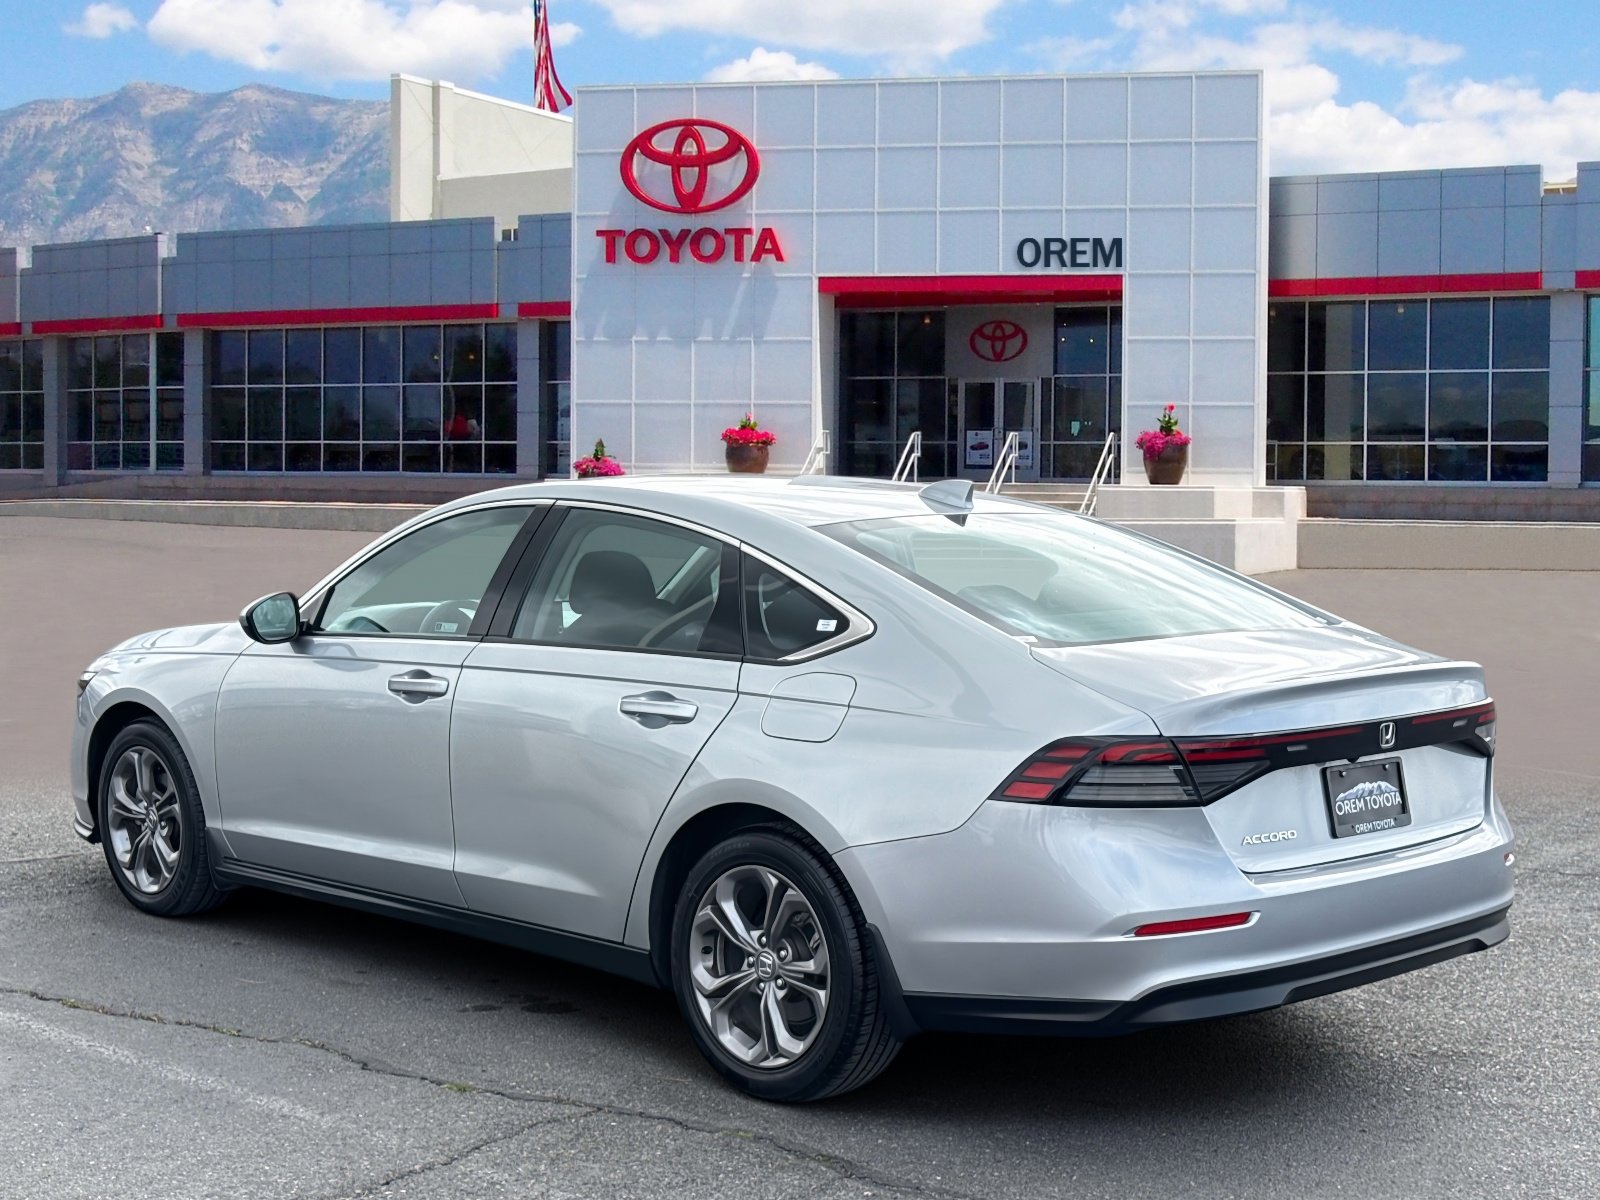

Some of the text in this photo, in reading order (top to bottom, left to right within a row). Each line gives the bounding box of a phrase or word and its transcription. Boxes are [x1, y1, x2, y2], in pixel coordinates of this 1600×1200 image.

[596, 227, 785, 264] TOYOTA
[1017, 237, 1123, 268] OREM
[1335, 791, 1402, 815] OREM TOYOTA
[1355, 818, 1395, 833] OREM TOYOTA
[1242, 830, 1298, 846] ACCORD
